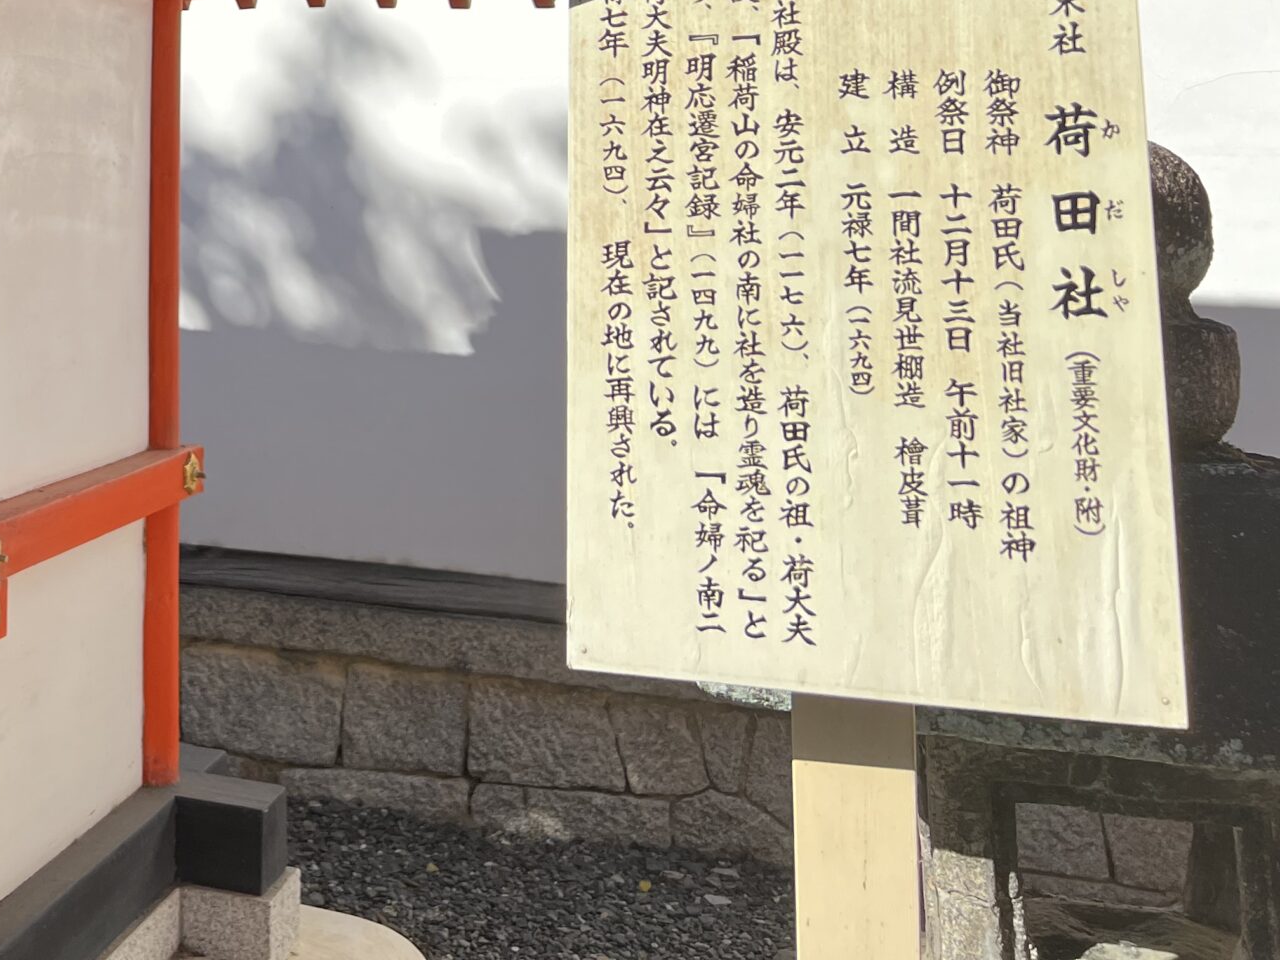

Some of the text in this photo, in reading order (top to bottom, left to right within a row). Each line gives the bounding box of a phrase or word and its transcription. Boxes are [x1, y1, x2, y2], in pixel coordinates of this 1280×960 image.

[840, 182, 875, 395] 元禄七年（一六九四）
[887, 190, 926, 409] 一間社流見世棚造
[932, 68, 984, 530] 例祭日 十二月十三日 午前十一時
[983, 68, 1037, 563] 御祭神 荷田氏（当社旧社家）の祖神
[1044, 101, 1109, 320] 荷田社
[894, 436, 929, 529] 檜皮葺
